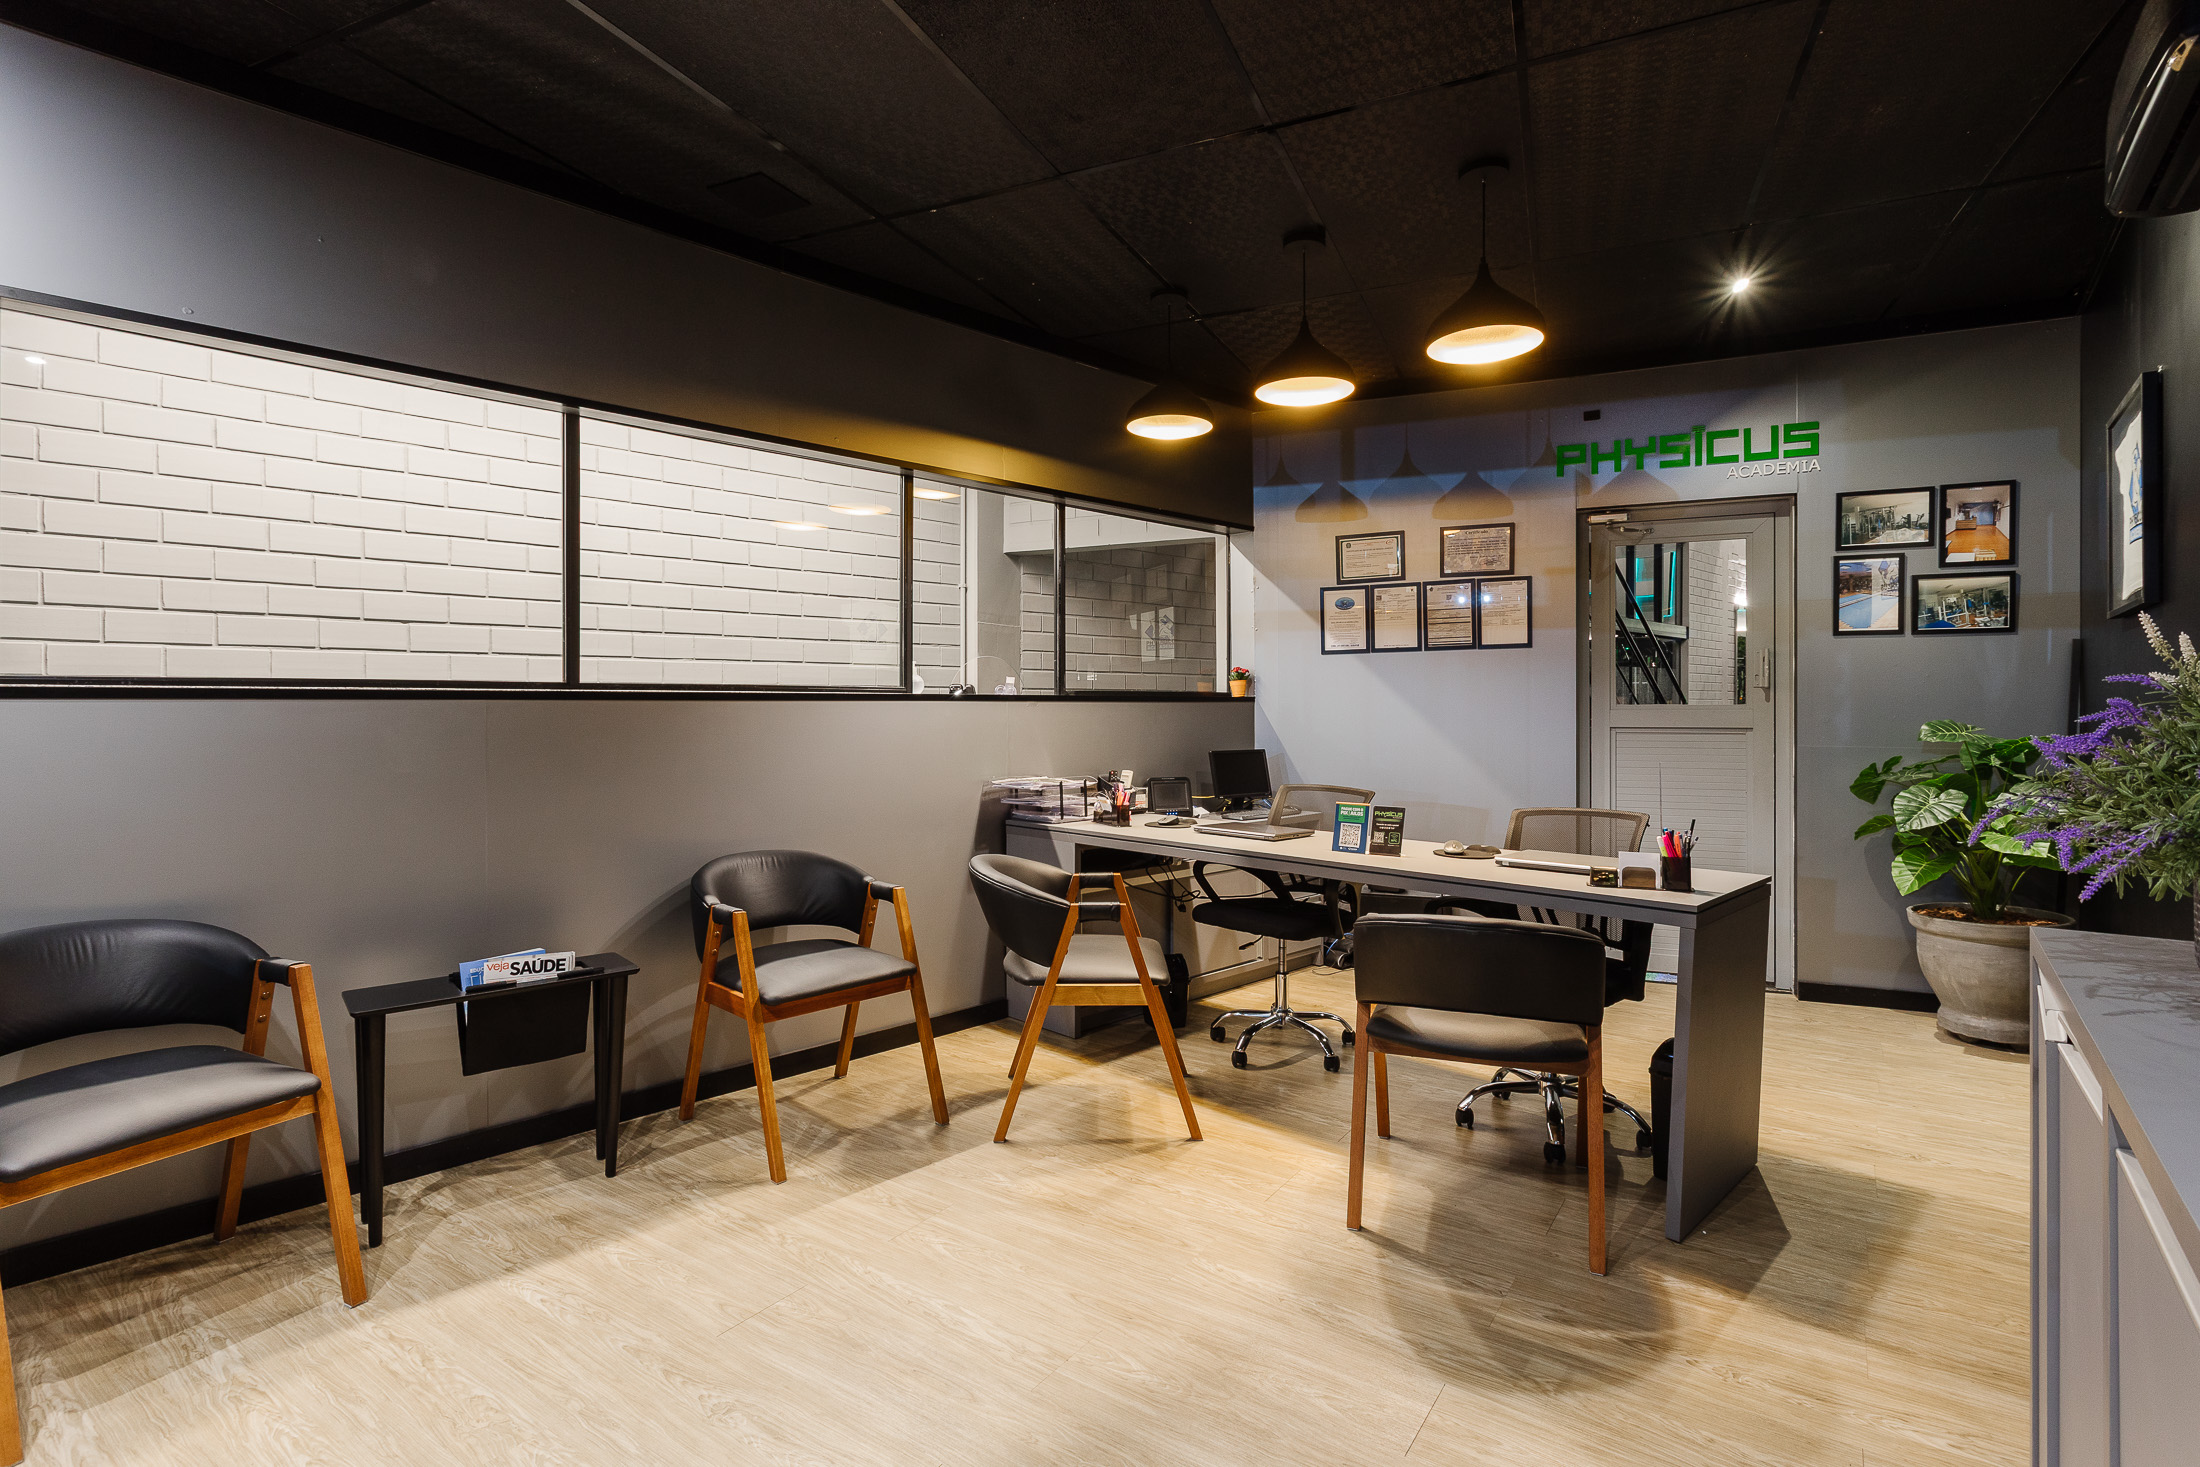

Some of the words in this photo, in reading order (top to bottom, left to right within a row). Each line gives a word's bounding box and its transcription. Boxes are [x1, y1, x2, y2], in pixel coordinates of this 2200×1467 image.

[1556, 421, 1820, 477] PHYSICUS
[1726, 458, 1821, 480] ACADEMIA
[487, 961, 509, 972] veja
[510, 958, 566, 976] SAÚDE
